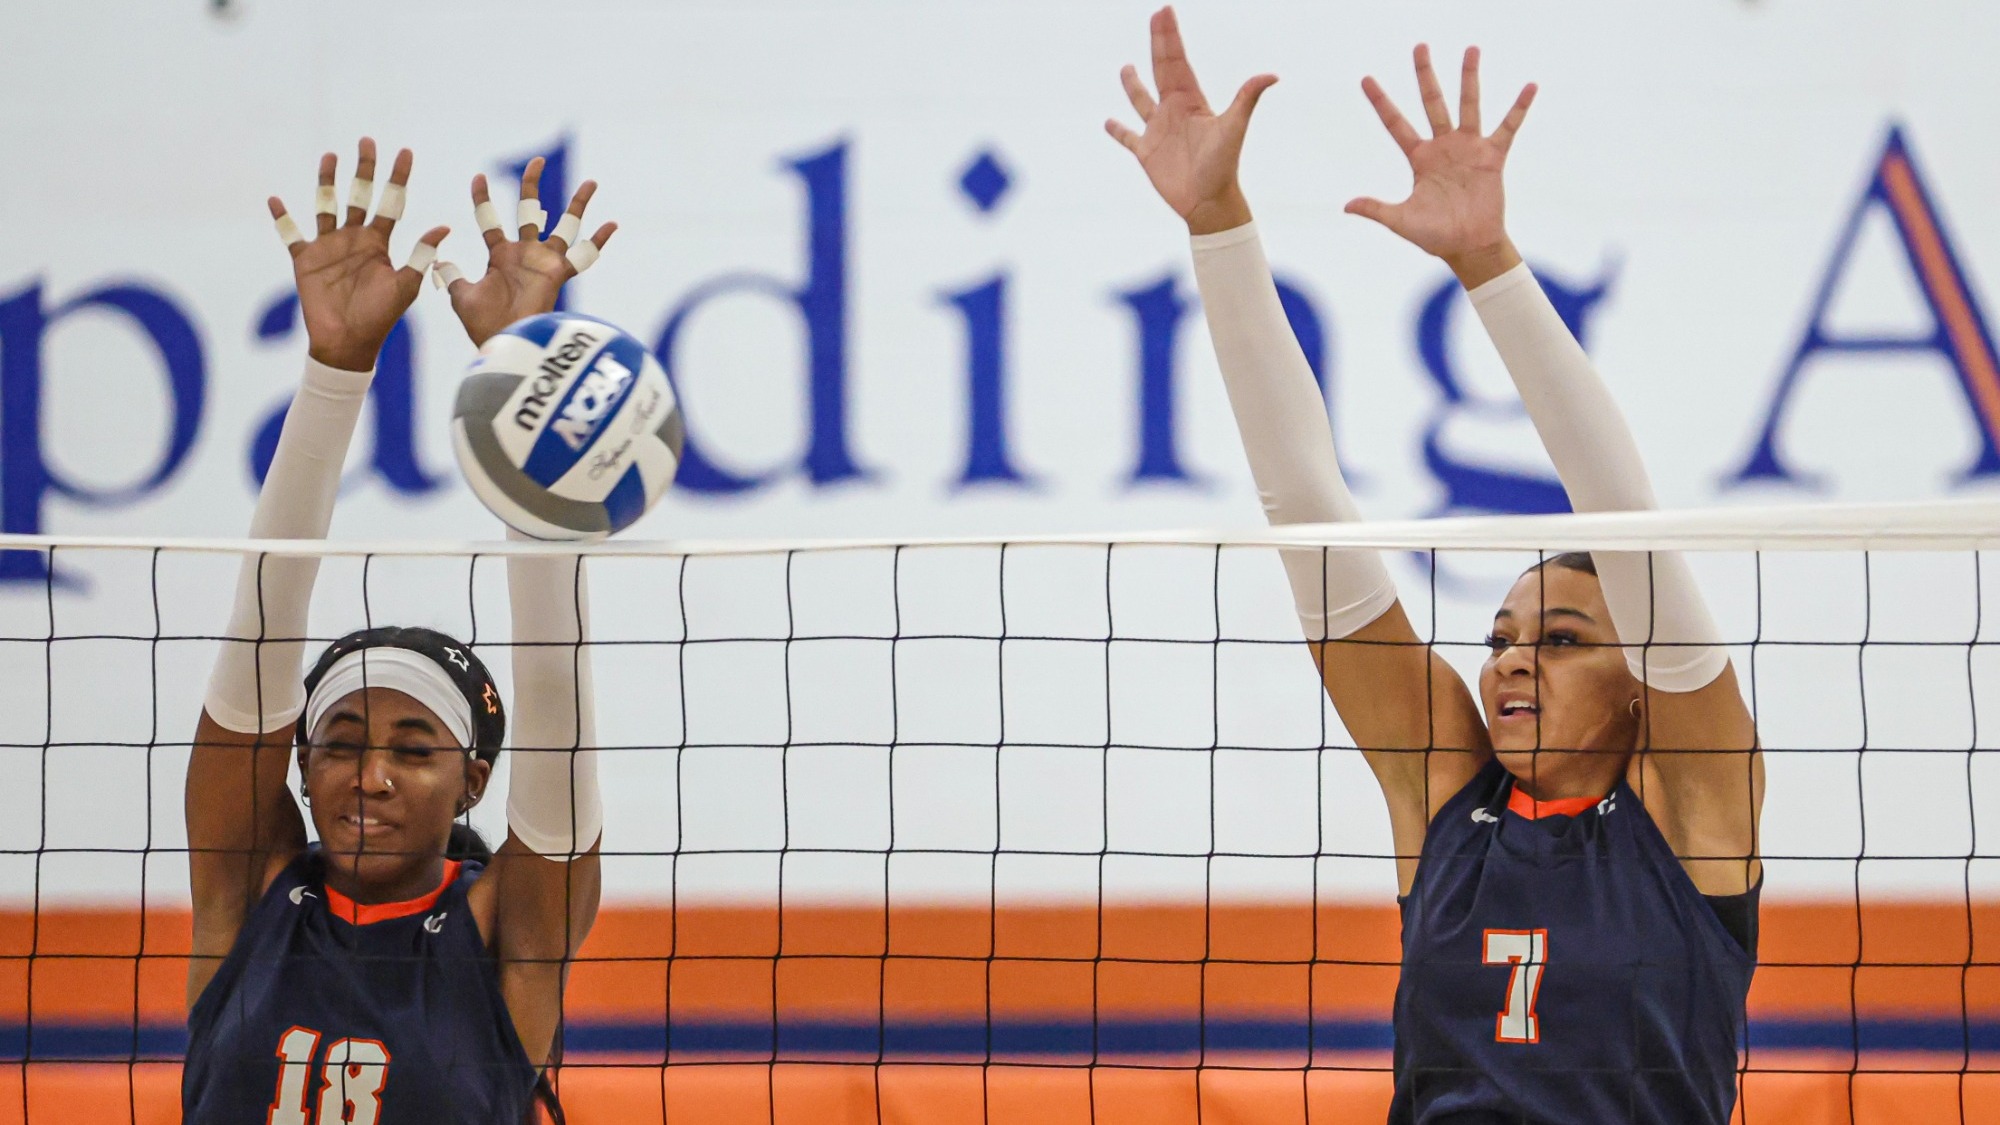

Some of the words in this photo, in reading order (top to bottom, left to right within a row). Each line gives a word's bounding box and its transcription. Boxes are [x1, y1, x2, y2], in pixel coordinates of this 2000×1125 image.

[1717, 118, 2000, 492] A
[514, 331, 599, 432] molten
[551, 351, 632, 451] NCAA
[1482, 928, 1548, 1043] 7
[265, 1024, 391, 1125] 18
